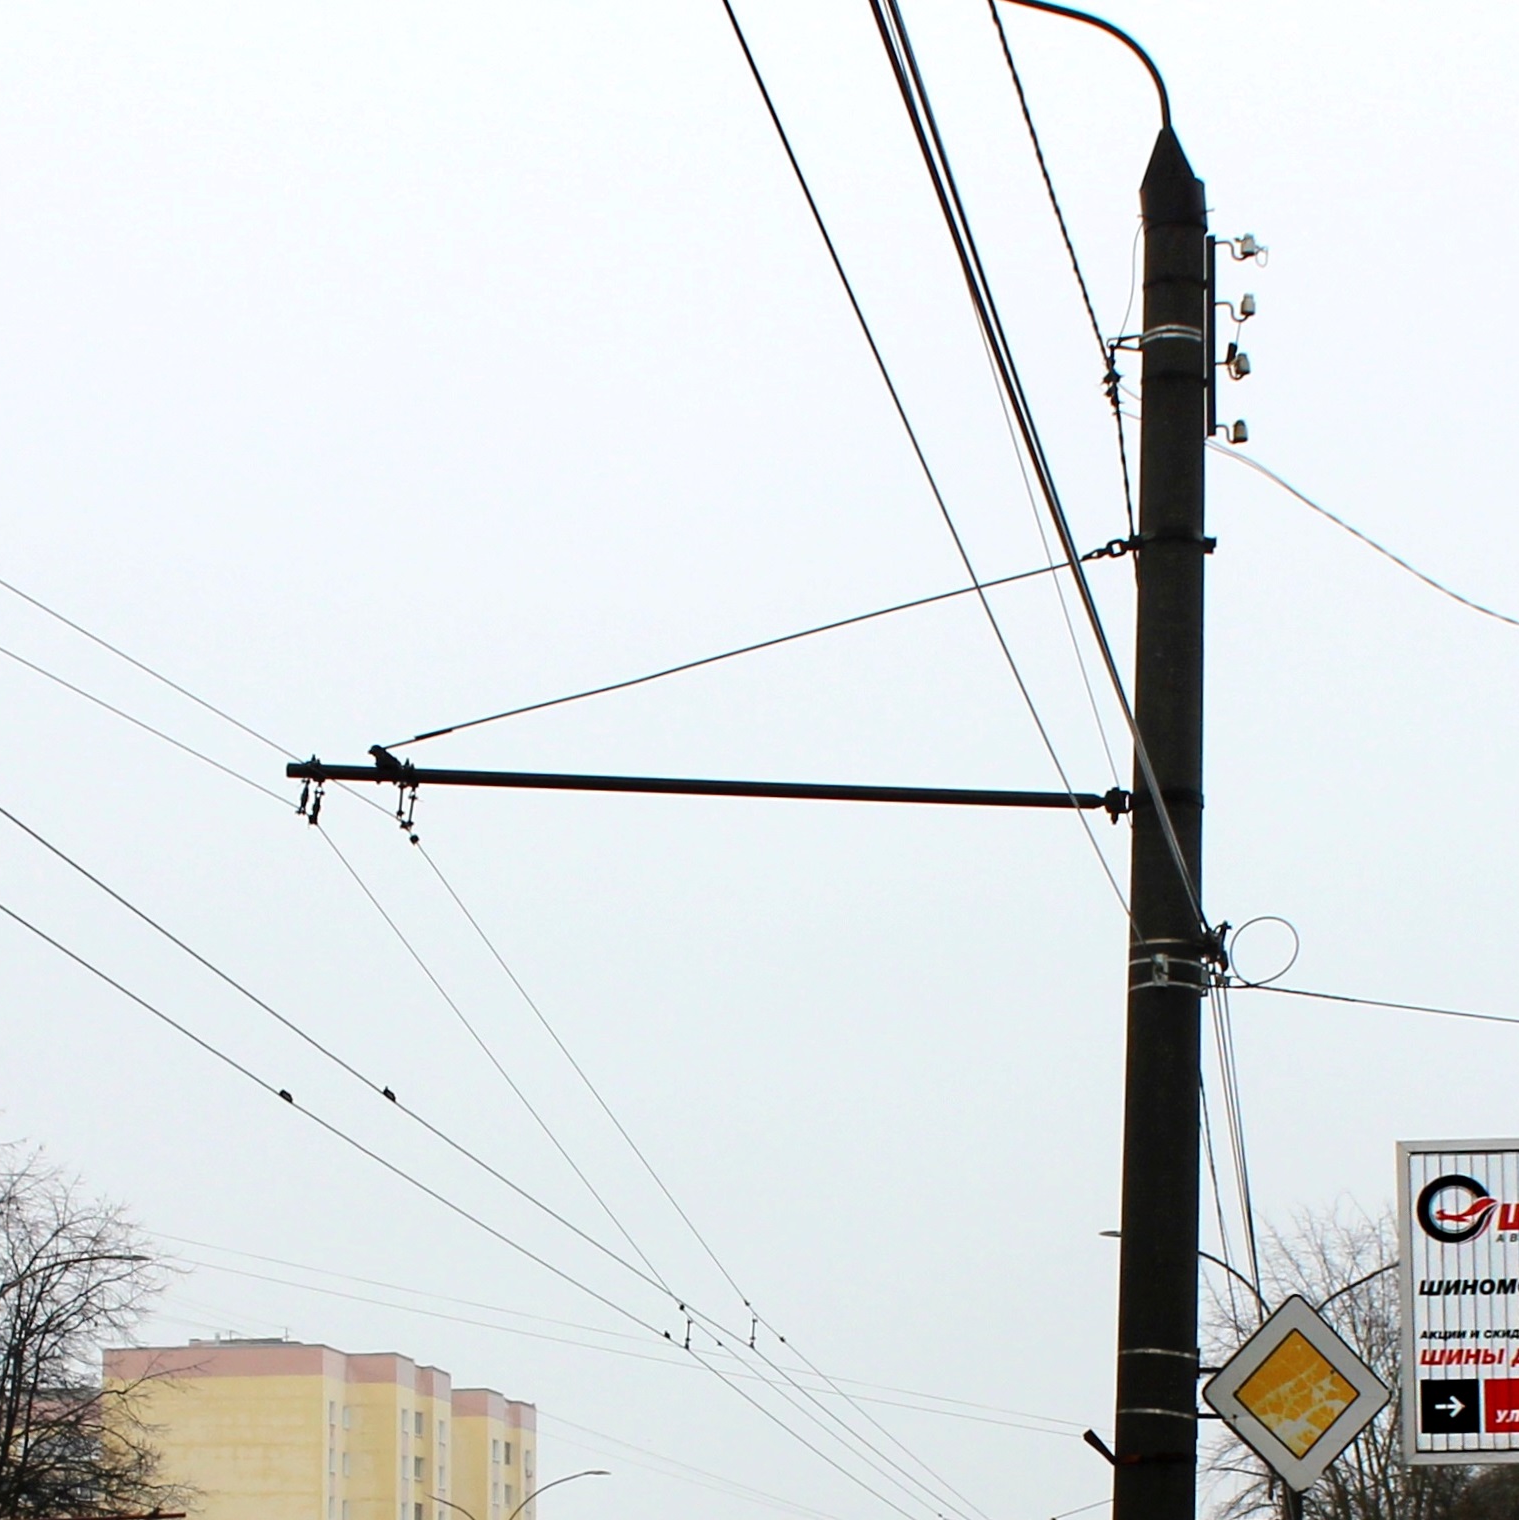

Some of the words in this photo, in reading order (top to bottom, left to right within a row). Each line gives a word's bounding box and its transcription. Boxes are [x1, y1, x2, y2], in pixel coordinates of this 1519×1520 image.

[1419, 1330, 1467, 1341] АКЦИИ
[1469, 1329, 1480, 1339] И
[1419, 1348, 1505, 1366] ШИНЫ
